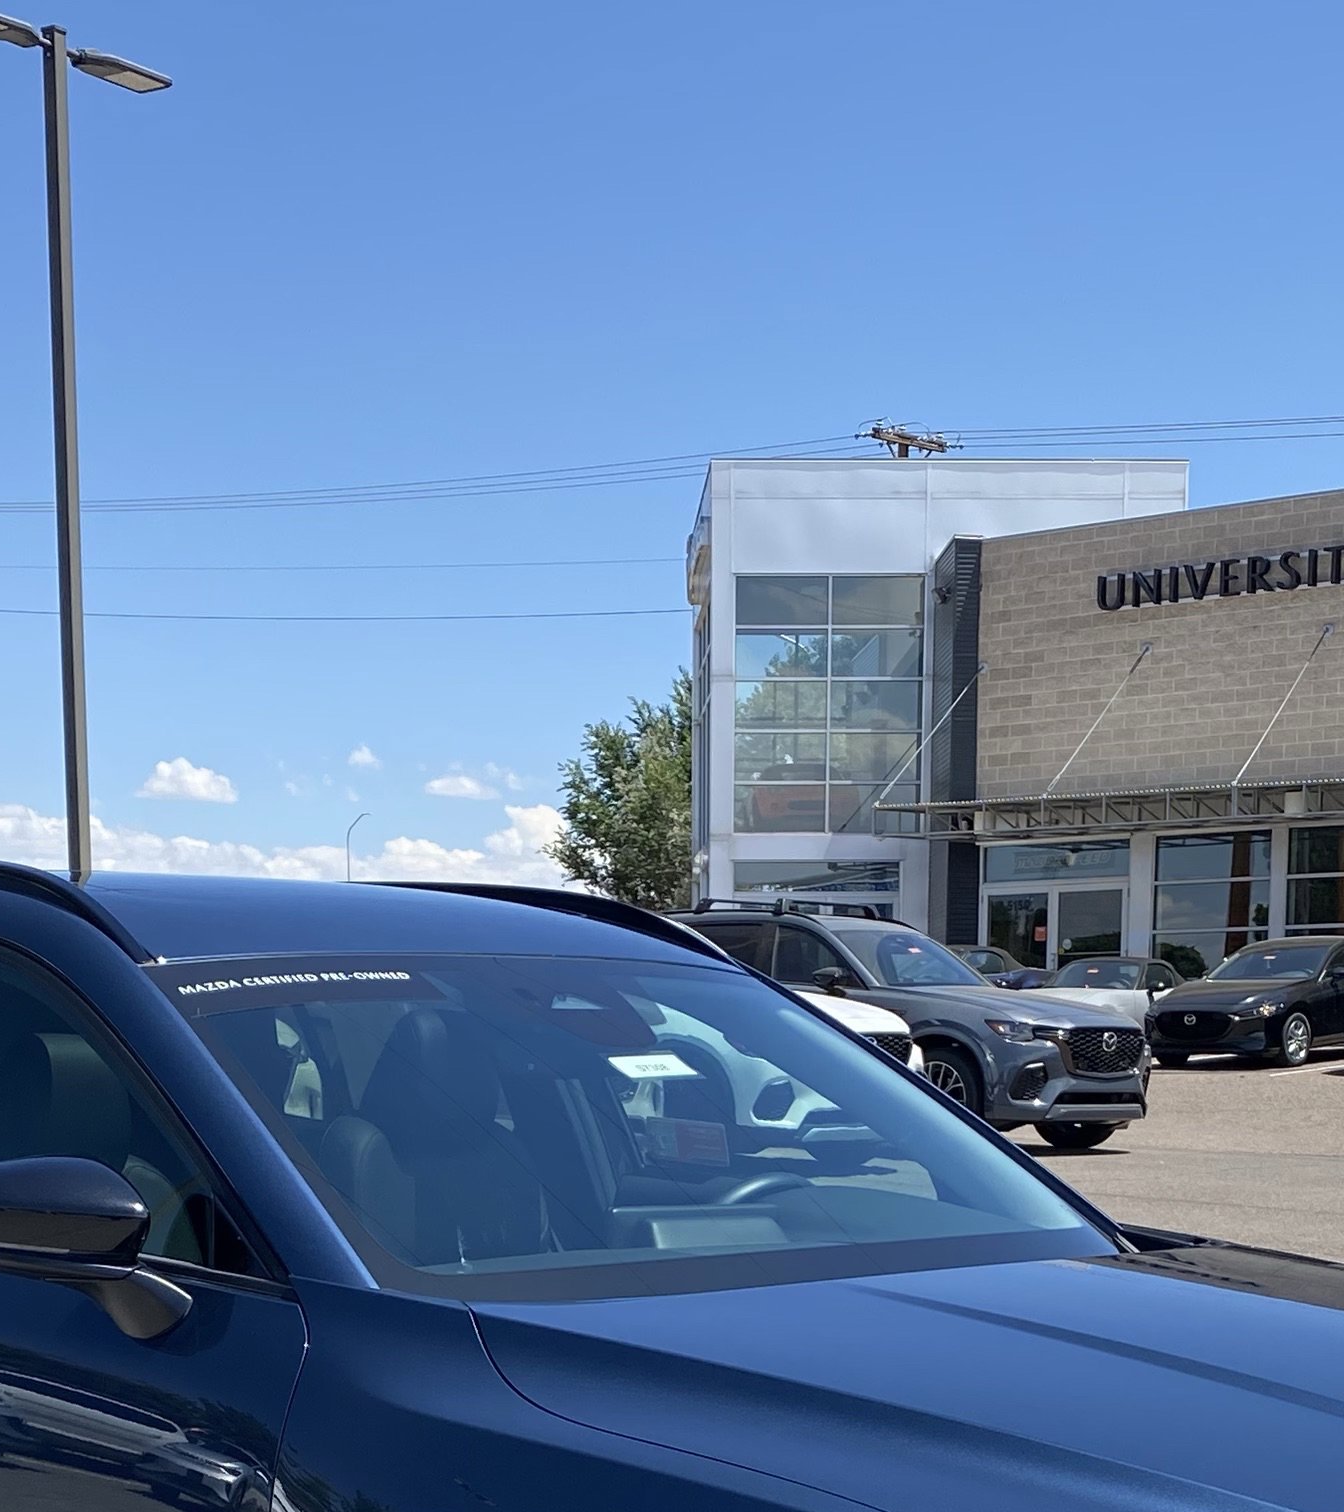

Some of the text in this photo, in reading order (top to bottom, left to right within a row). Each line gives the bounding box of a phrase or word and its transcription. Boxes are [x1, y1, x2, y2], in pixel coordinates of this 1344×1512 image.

[177, 971, 411, 995] MAZDA CERTIFIED PRE-OWNED
